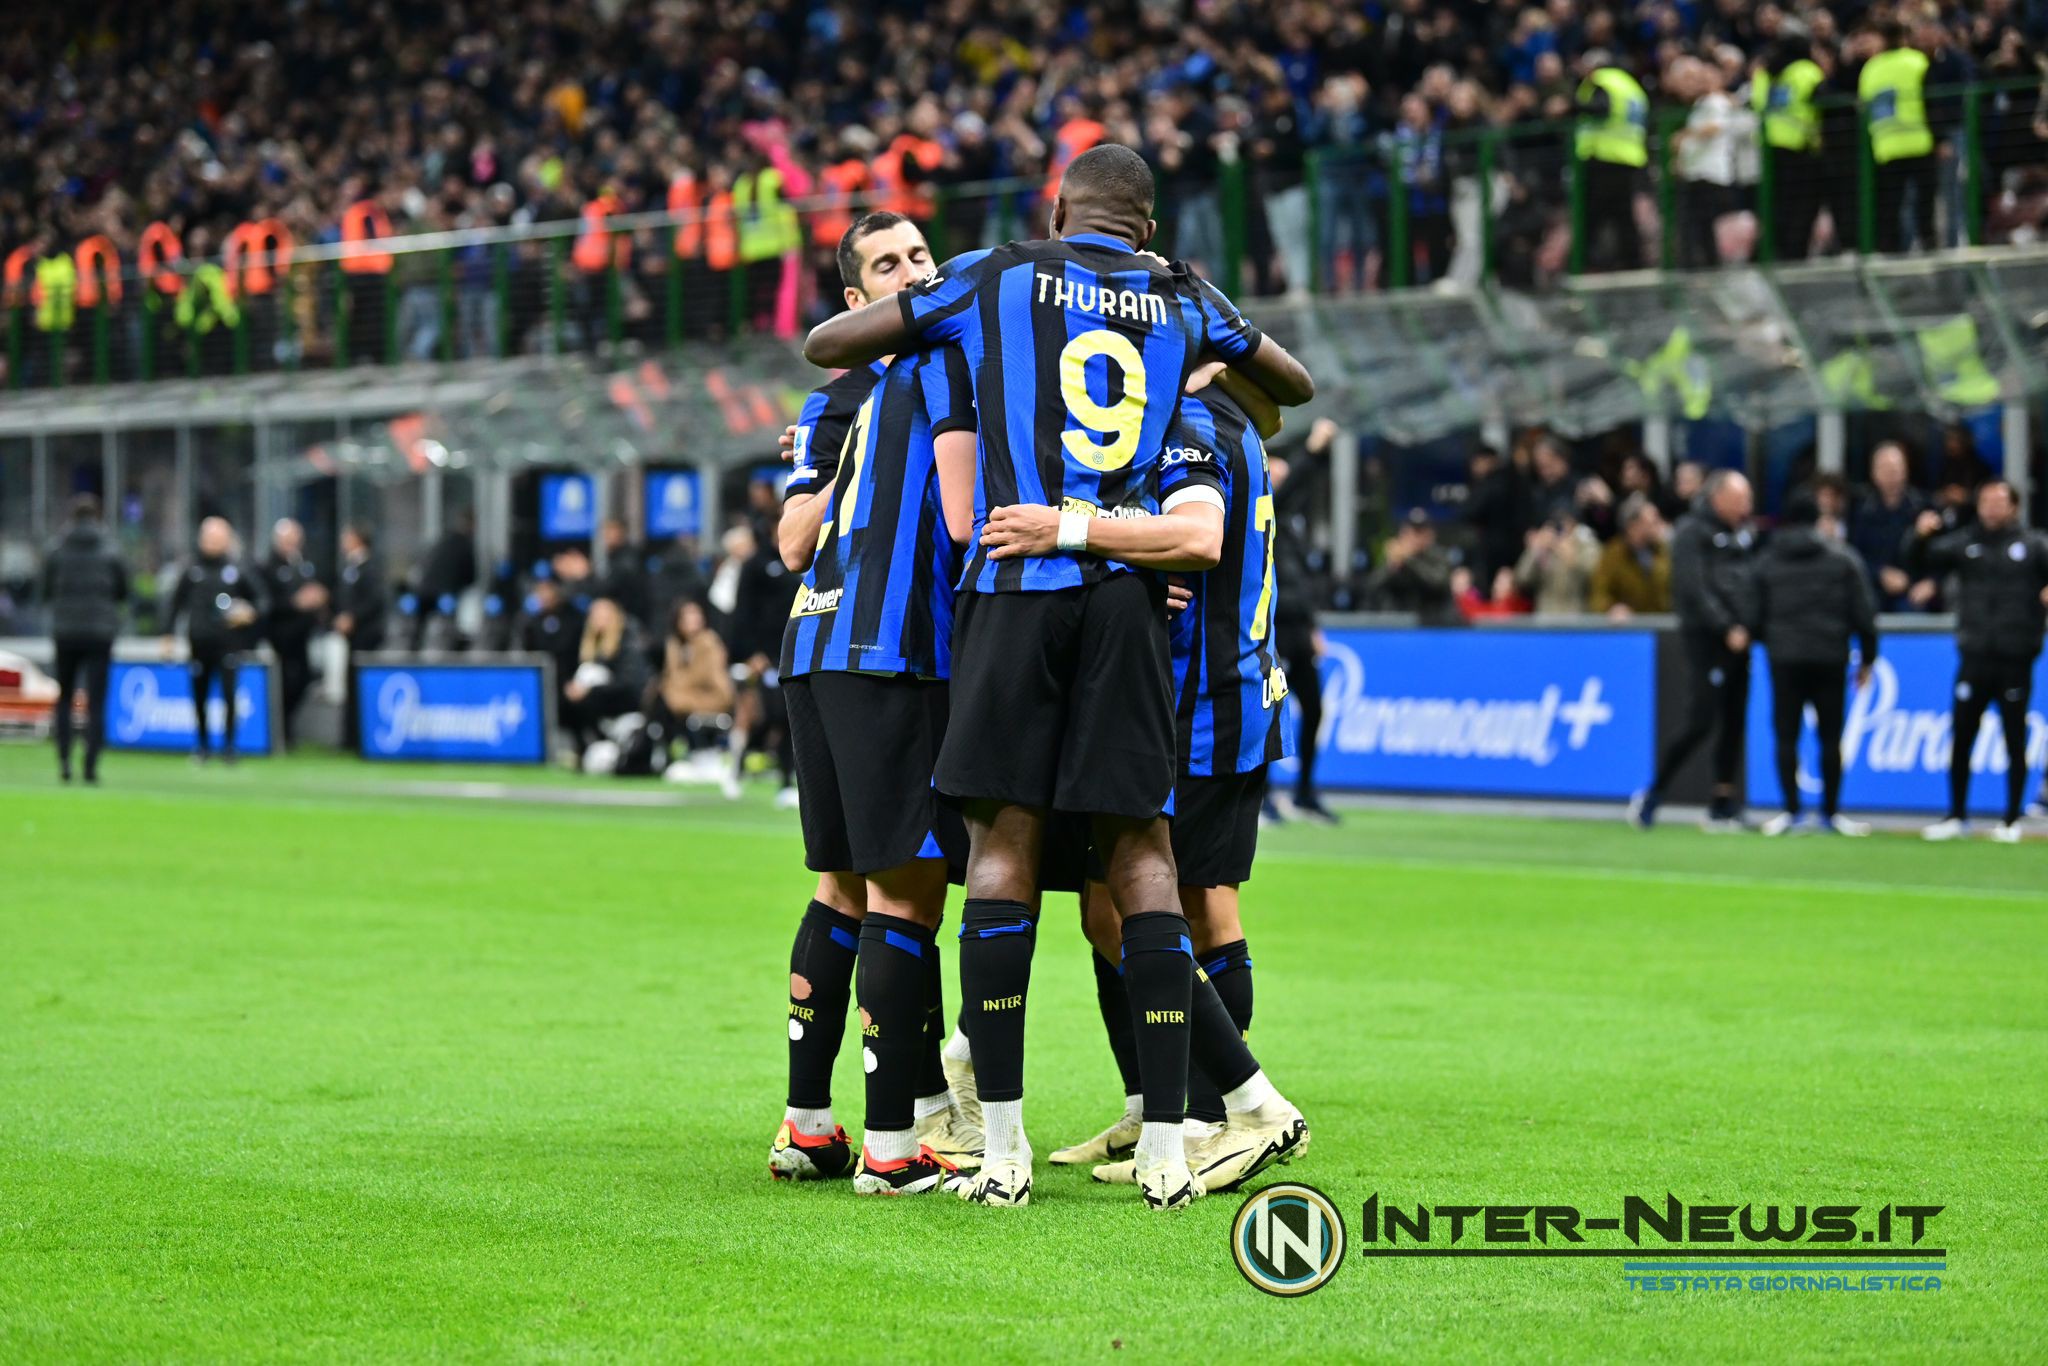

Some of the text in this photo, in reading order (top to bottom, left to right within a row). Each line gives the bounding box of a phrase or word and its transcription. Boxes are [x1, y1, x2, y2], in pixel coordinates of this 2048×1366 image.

[1036, 272, 1167, 325] THURAM
[1060, 329, 1148, 472] 9
[788, 1003, 815, 1022] NTER
[983, 995, 1021, 1011] INTER
[1146, 1010, 1185, 1024] INTER
